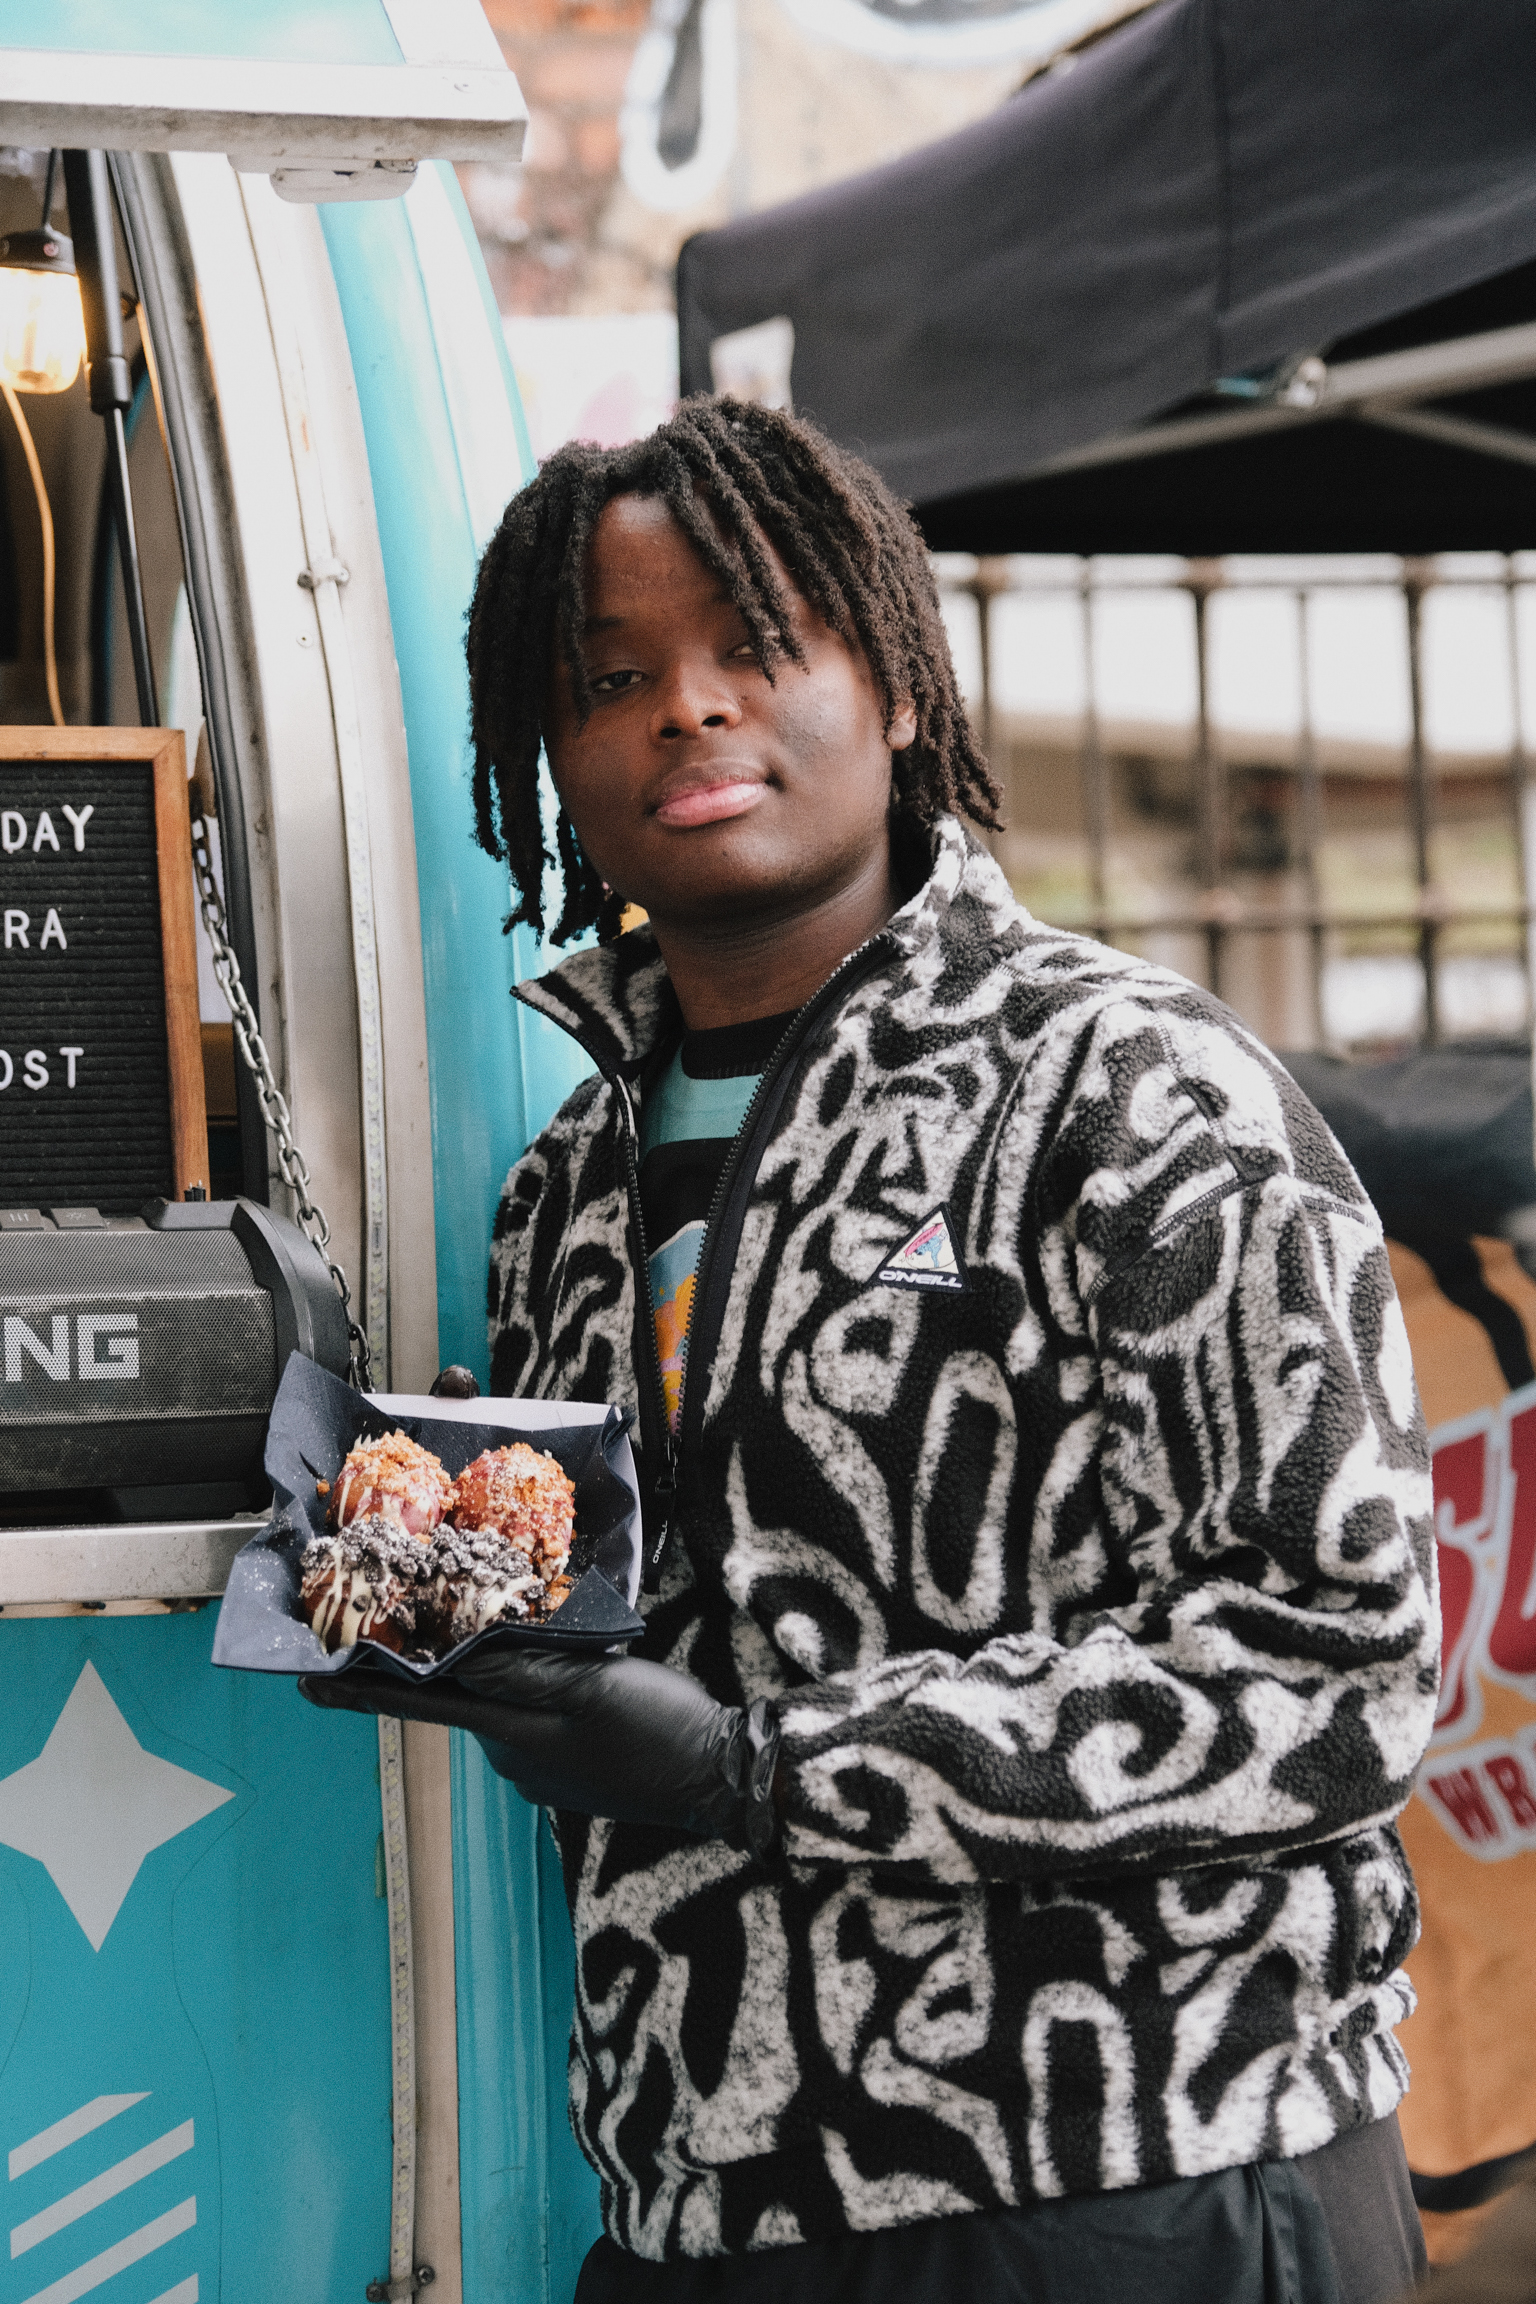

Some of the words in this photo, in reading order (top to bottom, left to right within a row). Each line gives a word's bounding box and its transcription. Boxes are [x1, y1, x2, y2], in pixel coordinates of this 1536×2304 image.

[1, 804, 95, 854] DAY
[4, 908, 67, 950] RA
[4, 1313, 139, 1381] NG
